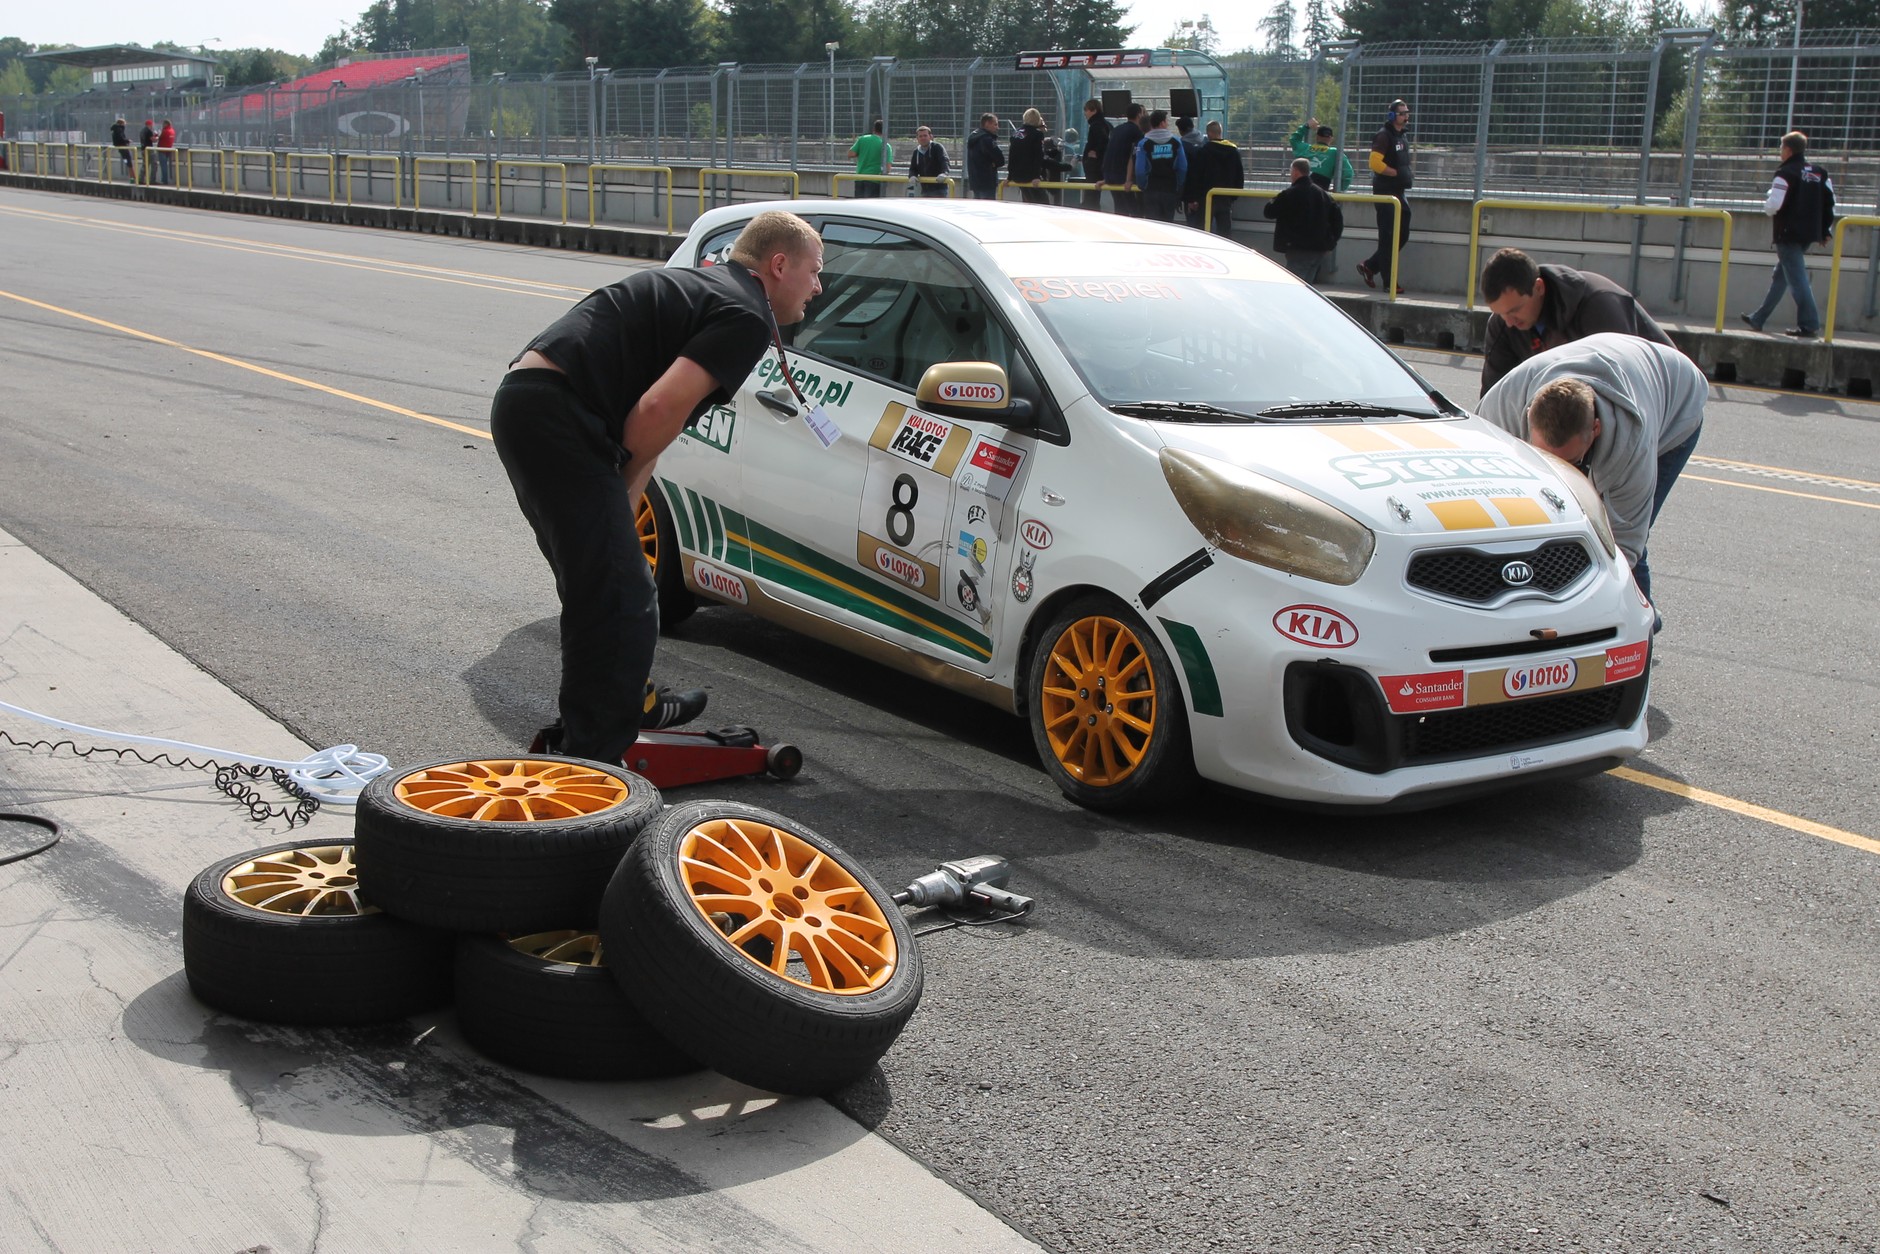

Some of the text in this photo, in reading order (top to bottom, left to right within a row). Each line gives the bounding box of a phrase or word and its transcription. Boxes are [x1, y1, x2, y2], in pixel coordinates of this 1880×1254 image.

[1014, 277, 1050, 304] 8
[752, 358, 854, 408] epien.pl
[959, 385, 996, 399] LOTOS
[906, 414, 948, 438] KIA LOTOS
[891, 425, 943, 463] RACE
[987, 451, 1015, 467] Santander
[886, 473, 918, 547] 8
[1026, 524, 1047, 546] KIA
[891, 557, 919, 582] LOTOS
[1508, 567, 1529, 579] KIA
[711, 572, 742, 600] LOTOS
[1289, 612, 1344, 643] KIA
[1614, 650, 1641, 666] Santander
[1415, 679, 1463, 694] Santander
[1529, 663, 1569, 688] LOTOS
[1415, 694, 1456, 704] CONSUMER BANK
